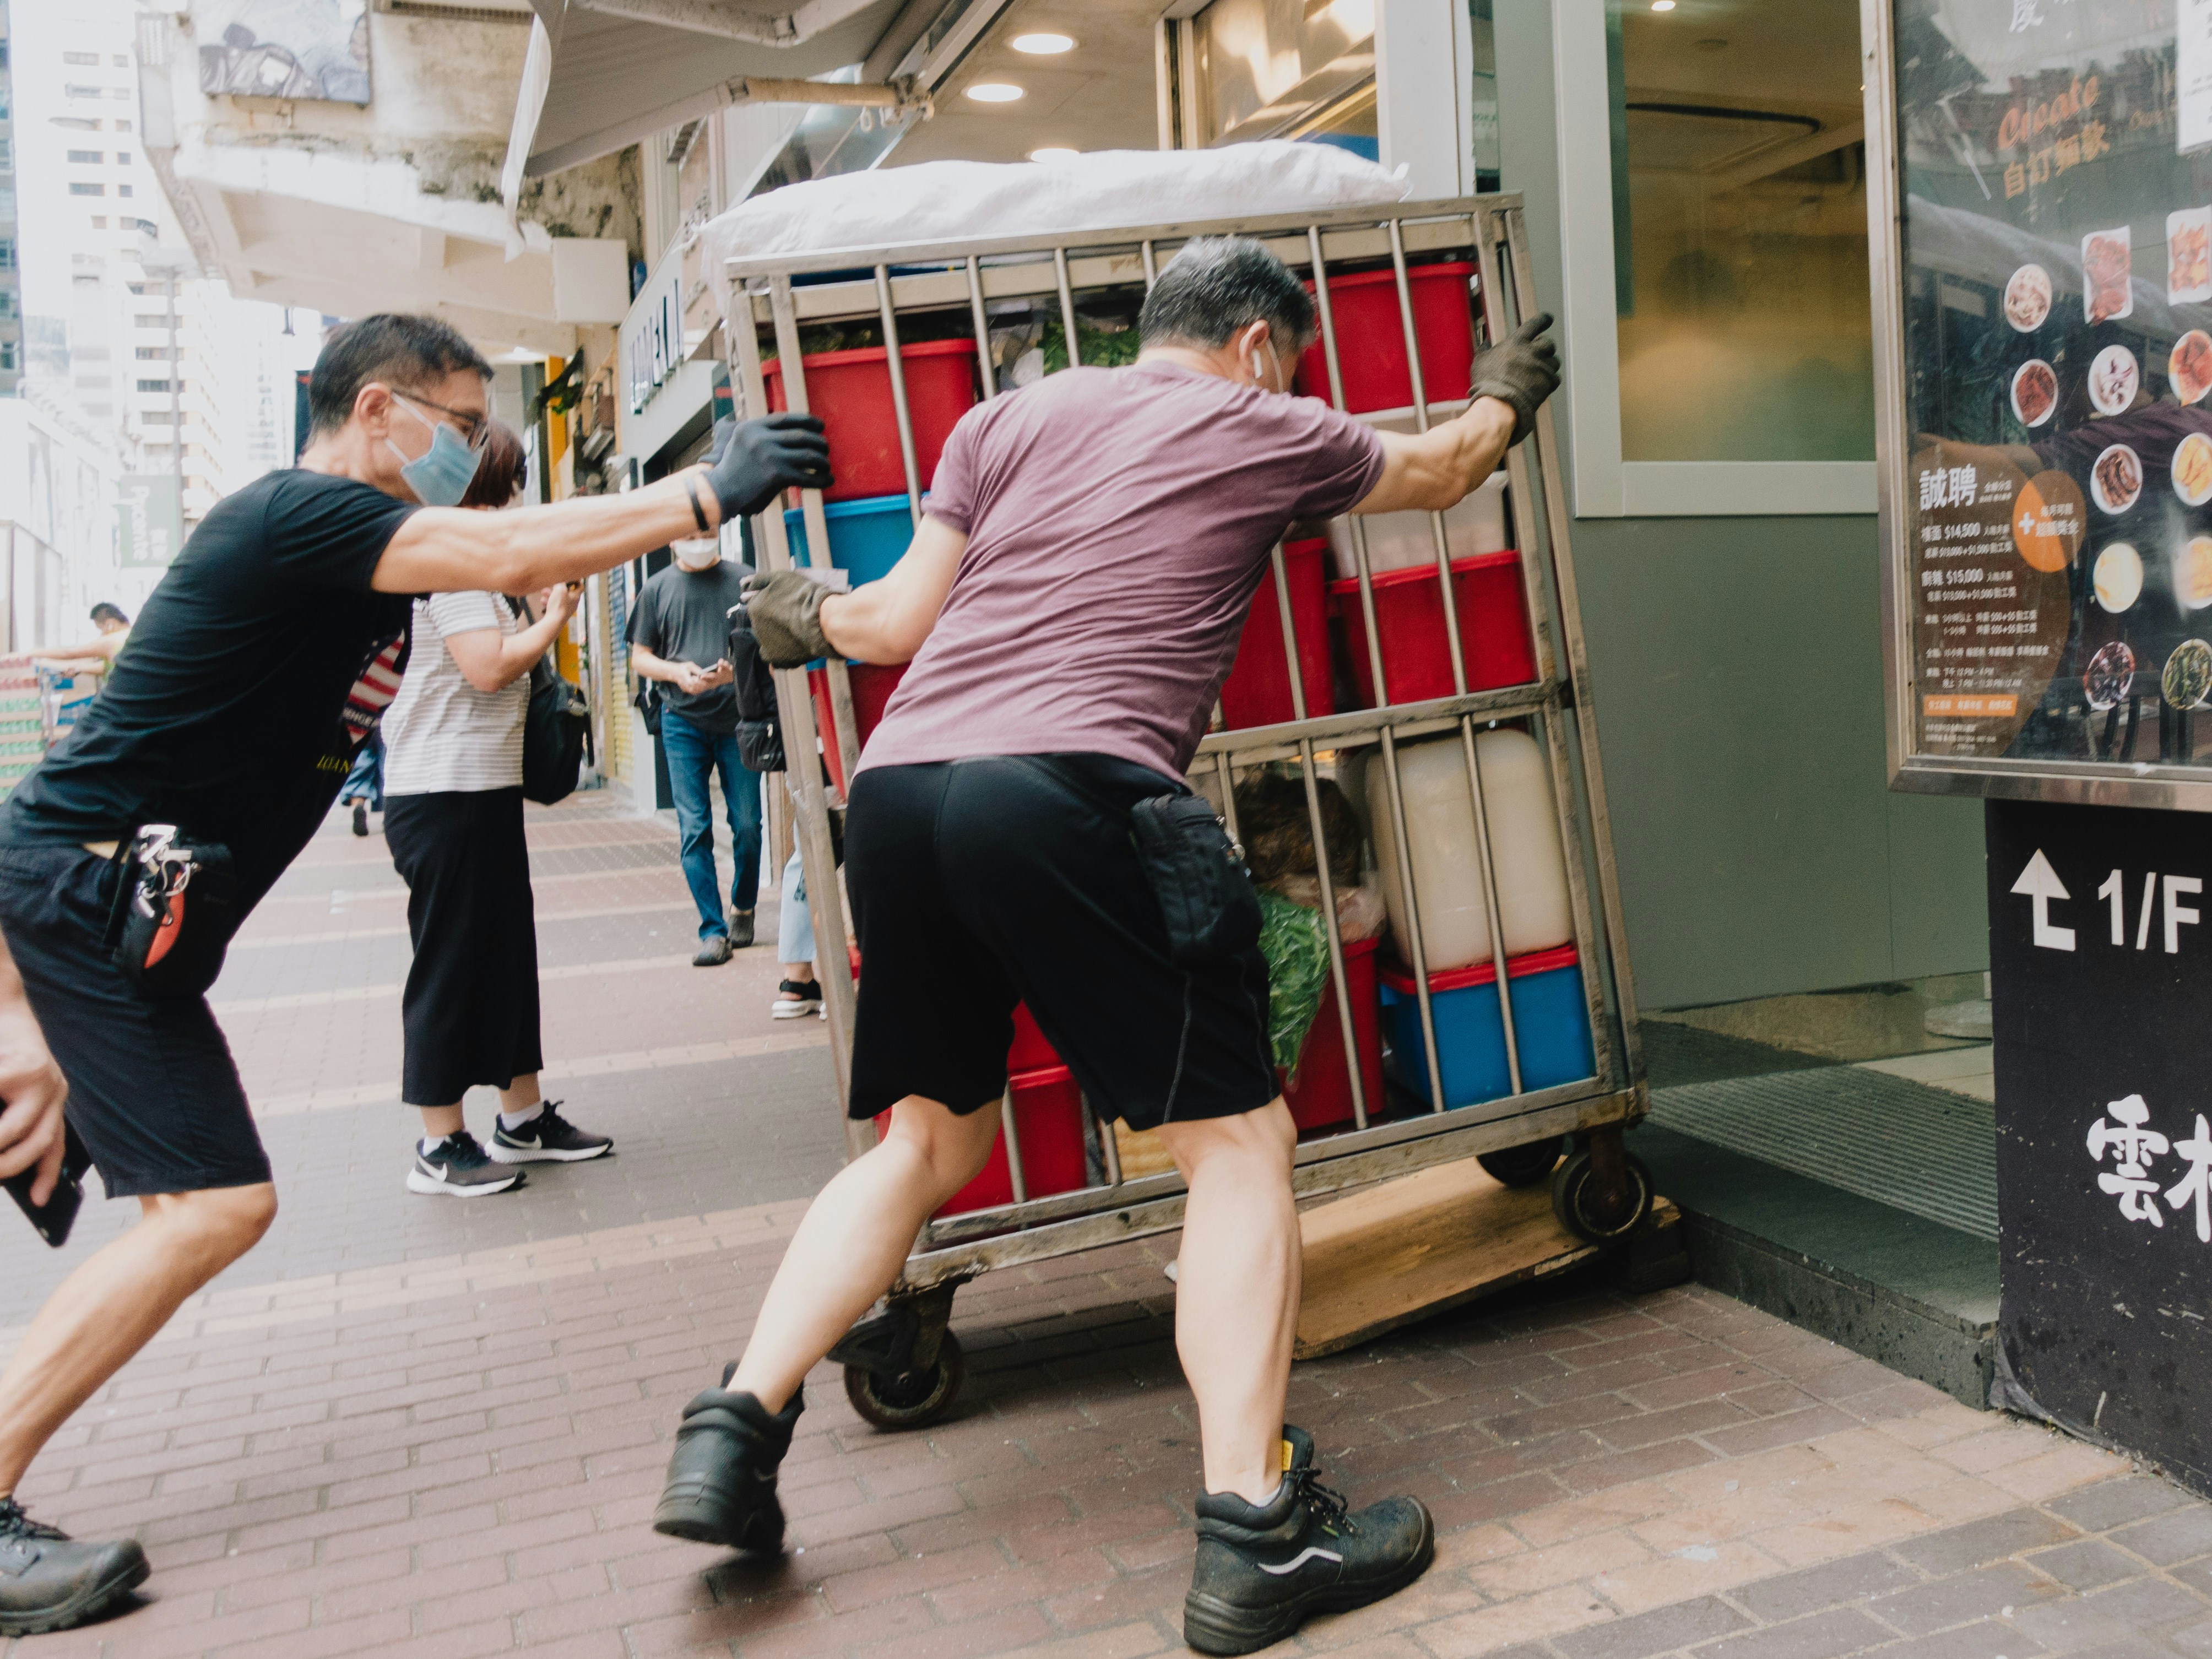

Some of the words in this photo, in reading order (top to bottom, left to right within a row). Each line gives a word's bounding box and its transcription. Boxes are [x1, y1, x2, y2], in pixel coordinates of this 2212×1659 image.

[1919, 463, 1978, 511] 誠聘
[1944, 522, 1981, 540] $14,500
[1945, 568, 1983, 586] $15,000
[2098, 869, 2202, 954] 1/F
